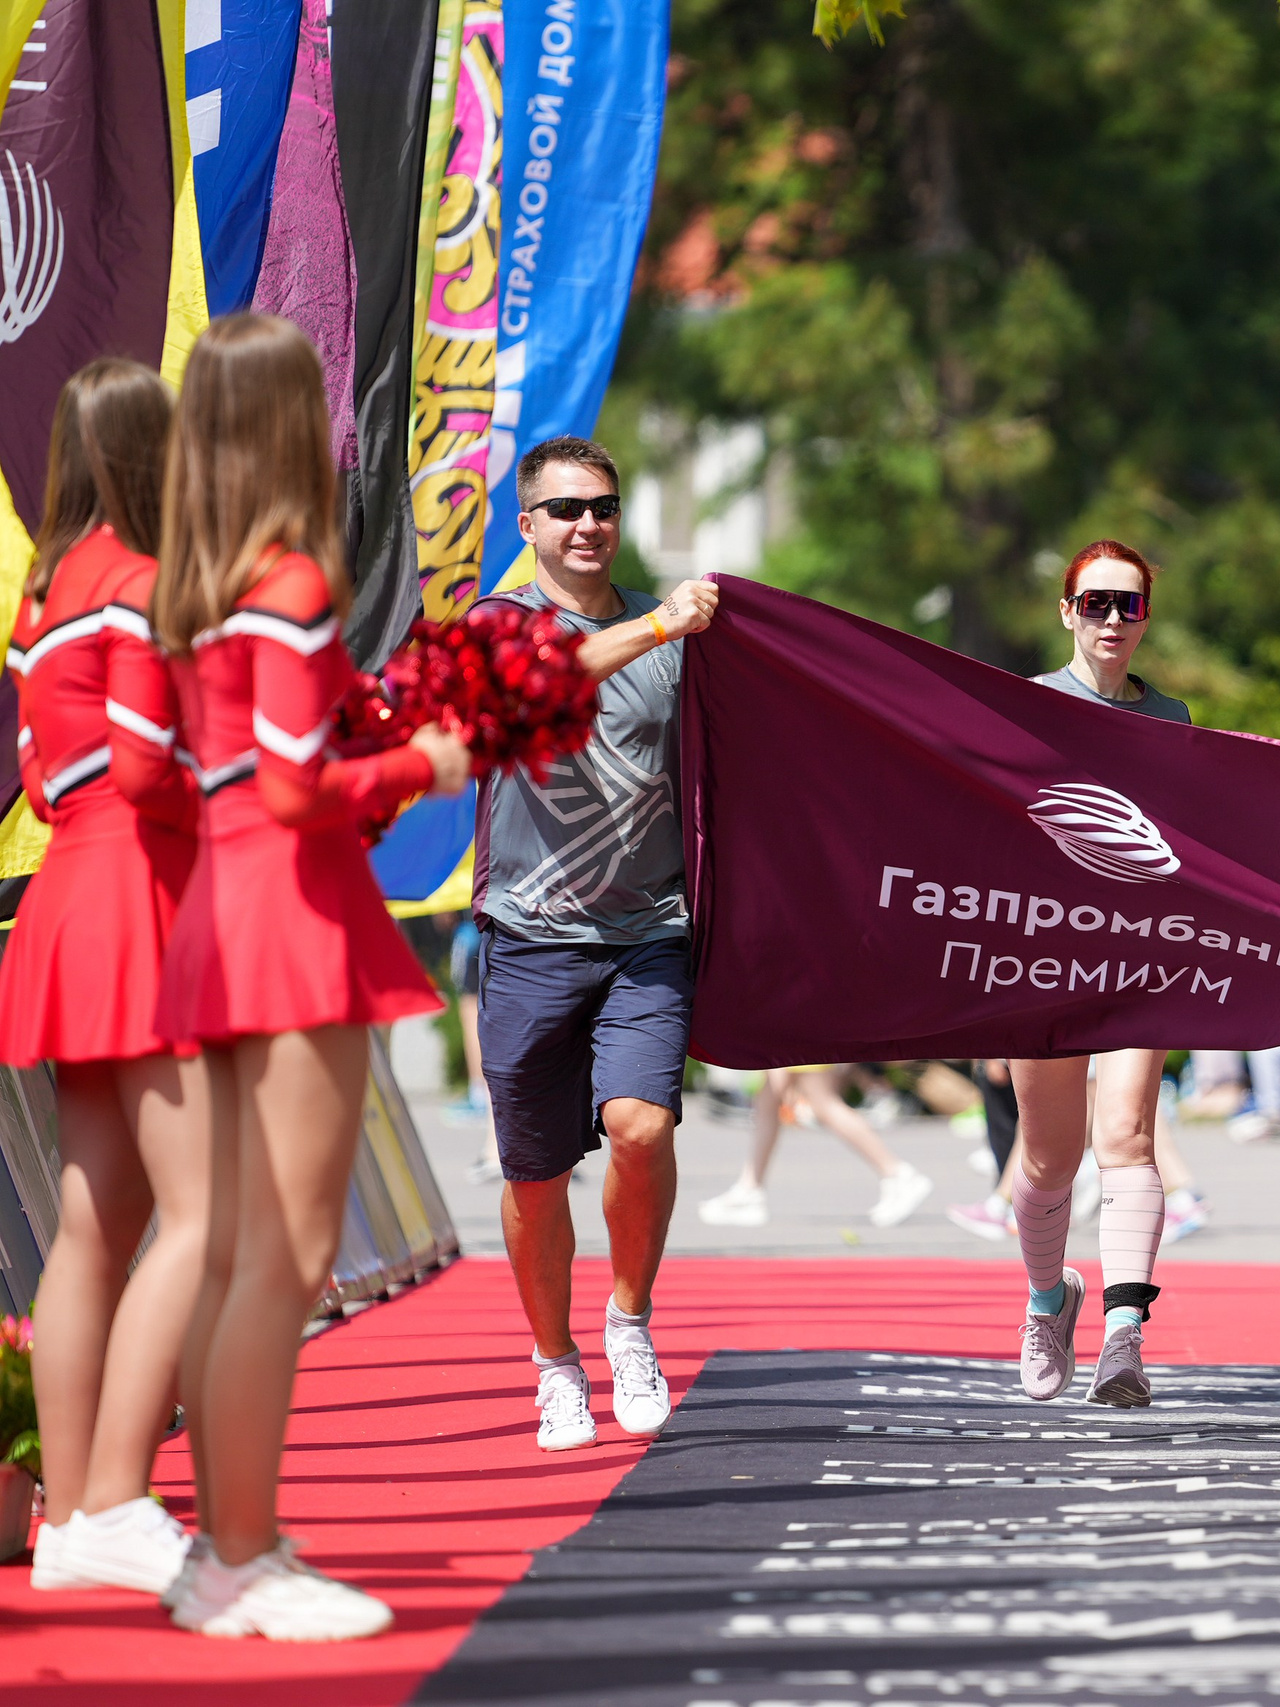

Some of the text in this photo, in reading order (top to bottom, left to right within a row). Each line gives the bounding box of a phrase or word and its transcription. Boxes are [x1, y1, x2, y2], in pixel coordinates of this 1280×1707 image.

[501, 0, 575, 337] СТРАХОВОЙ ДОМ
[940, 940, 1232, 1004] Премиум
